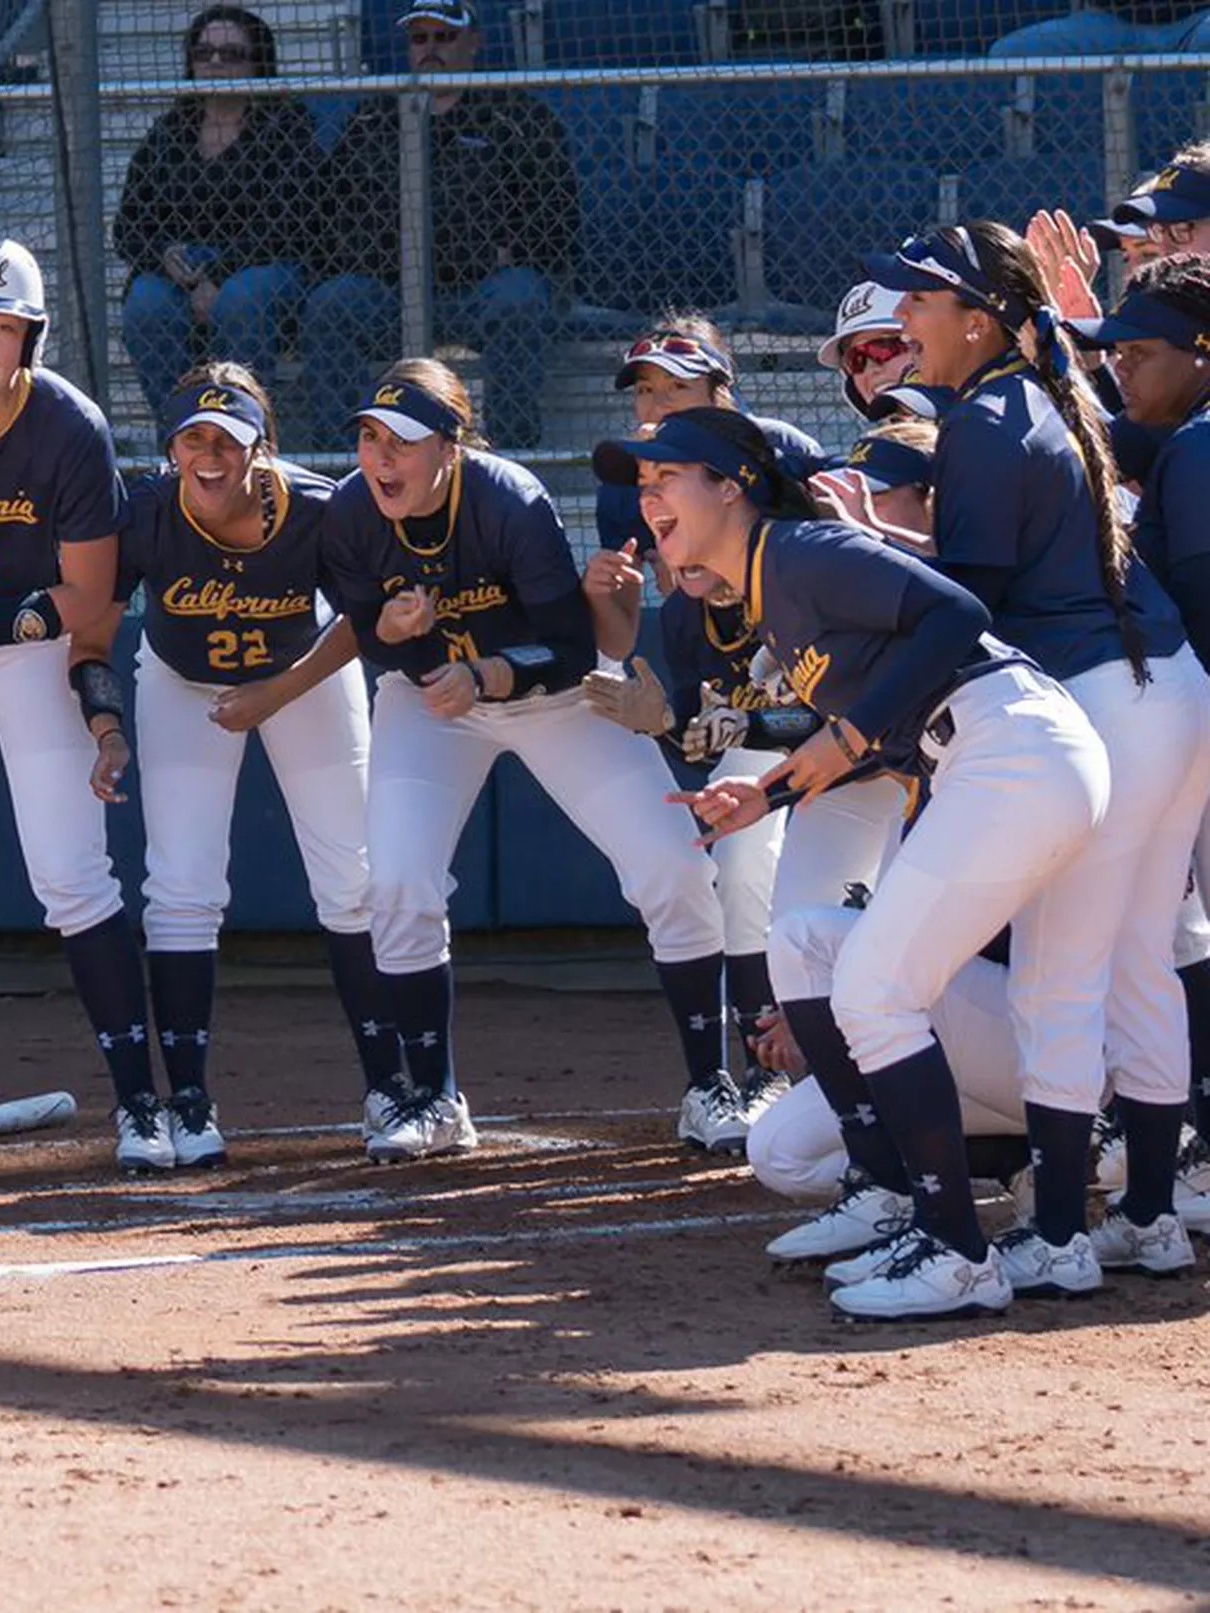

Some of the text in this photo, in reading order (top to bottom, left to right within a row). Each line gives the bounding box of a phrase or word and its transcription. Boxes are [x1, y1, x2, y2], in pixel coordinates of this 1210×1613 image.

[841, 285, 878, 325] Cal
[198, 389, 228, 410] Cal
[373, 385, 403, 405] Cal
[162, 576, 313, 619] California
[206, 629, 274, 669] 22
